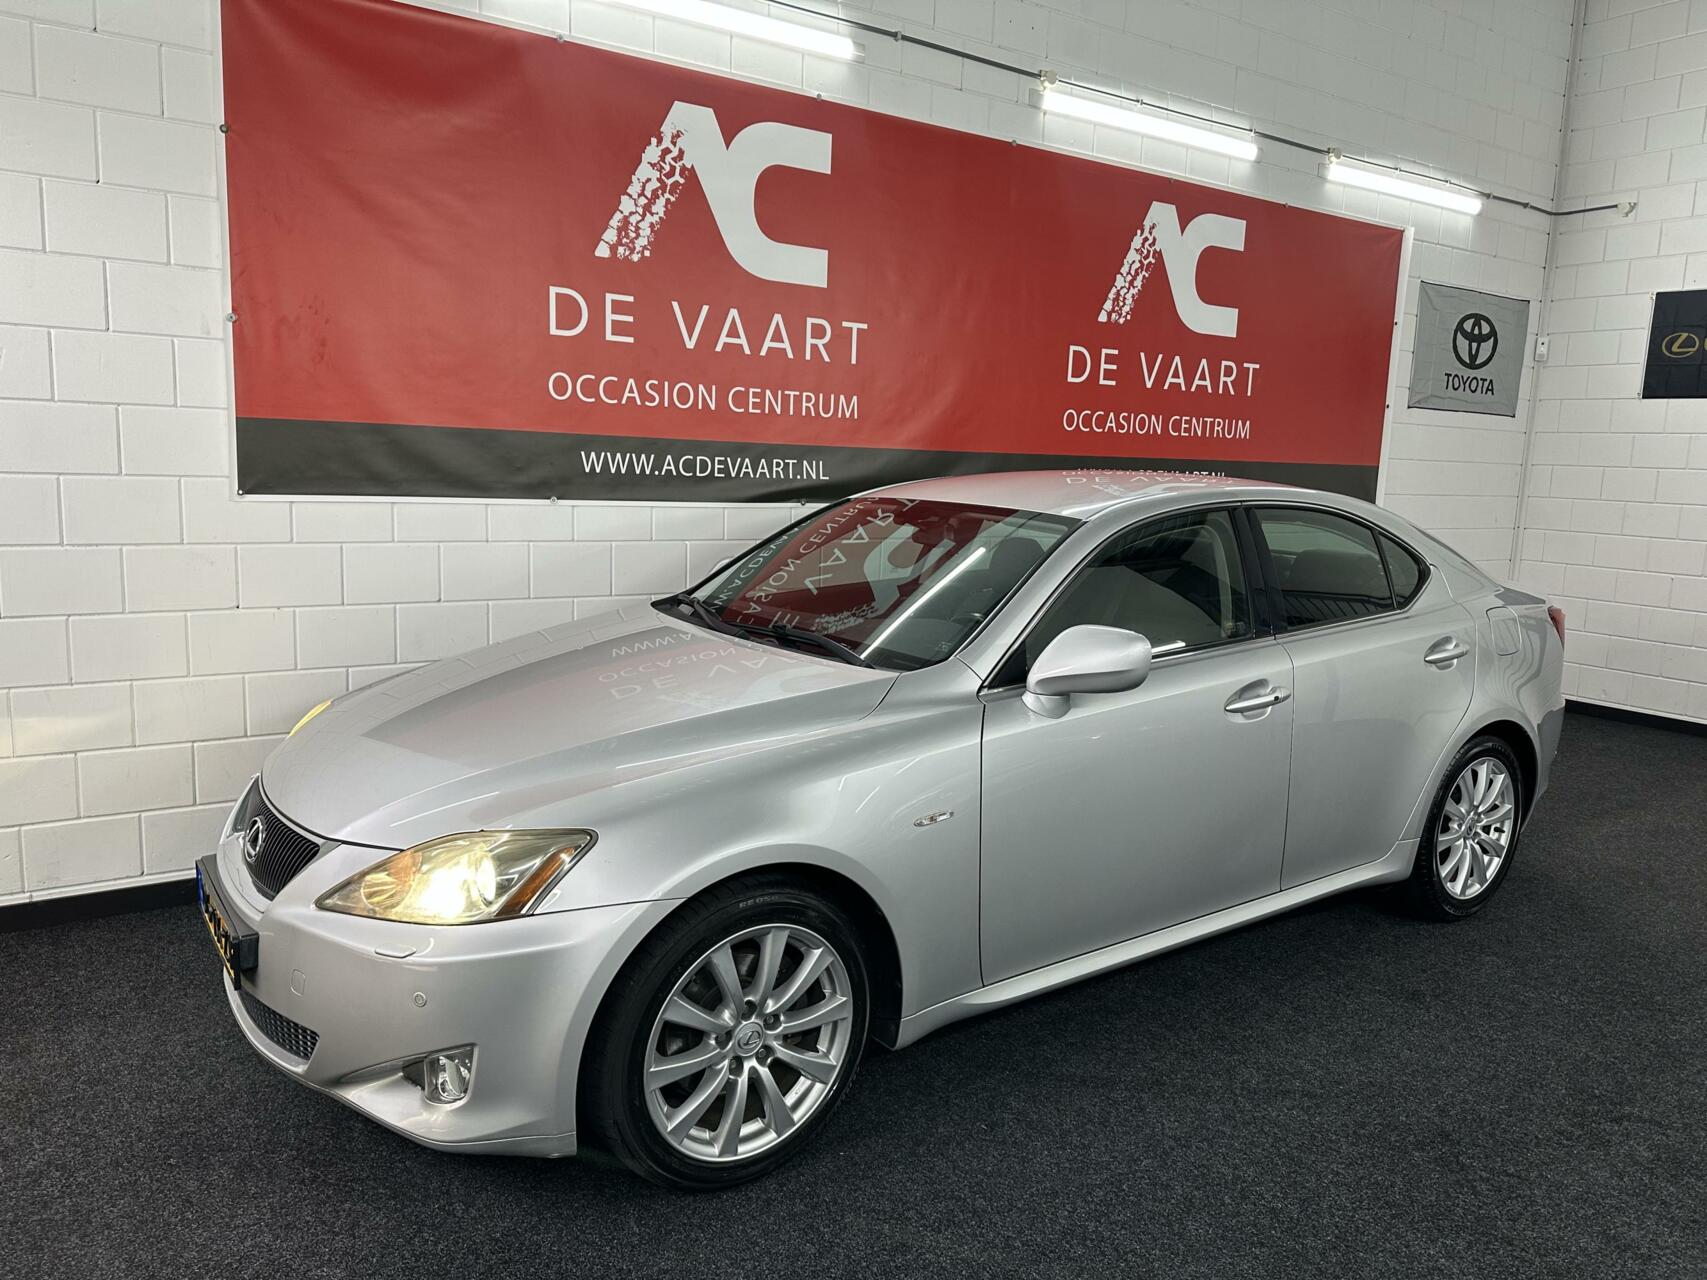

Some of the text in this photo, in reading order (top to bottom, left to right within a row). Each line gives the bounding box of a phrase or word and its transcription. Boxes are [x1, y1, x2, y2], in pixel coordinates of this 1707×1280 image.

[594, 100, 832, 288] AC
[1097, 200, 1247, 338] AC
[548, 285, 869, 365] DE VAART
[547, 371, 860, 420] OCCASION CENTRUM
[1066, 344, 1261, 397] DE VAART
[1444, 372, 1495, 397] TOYOTA
[1062, 408, 1251, 440] OCCASION CENTRUM
[580, 450, 830, 481] WWW.ACDEVAART.NL
